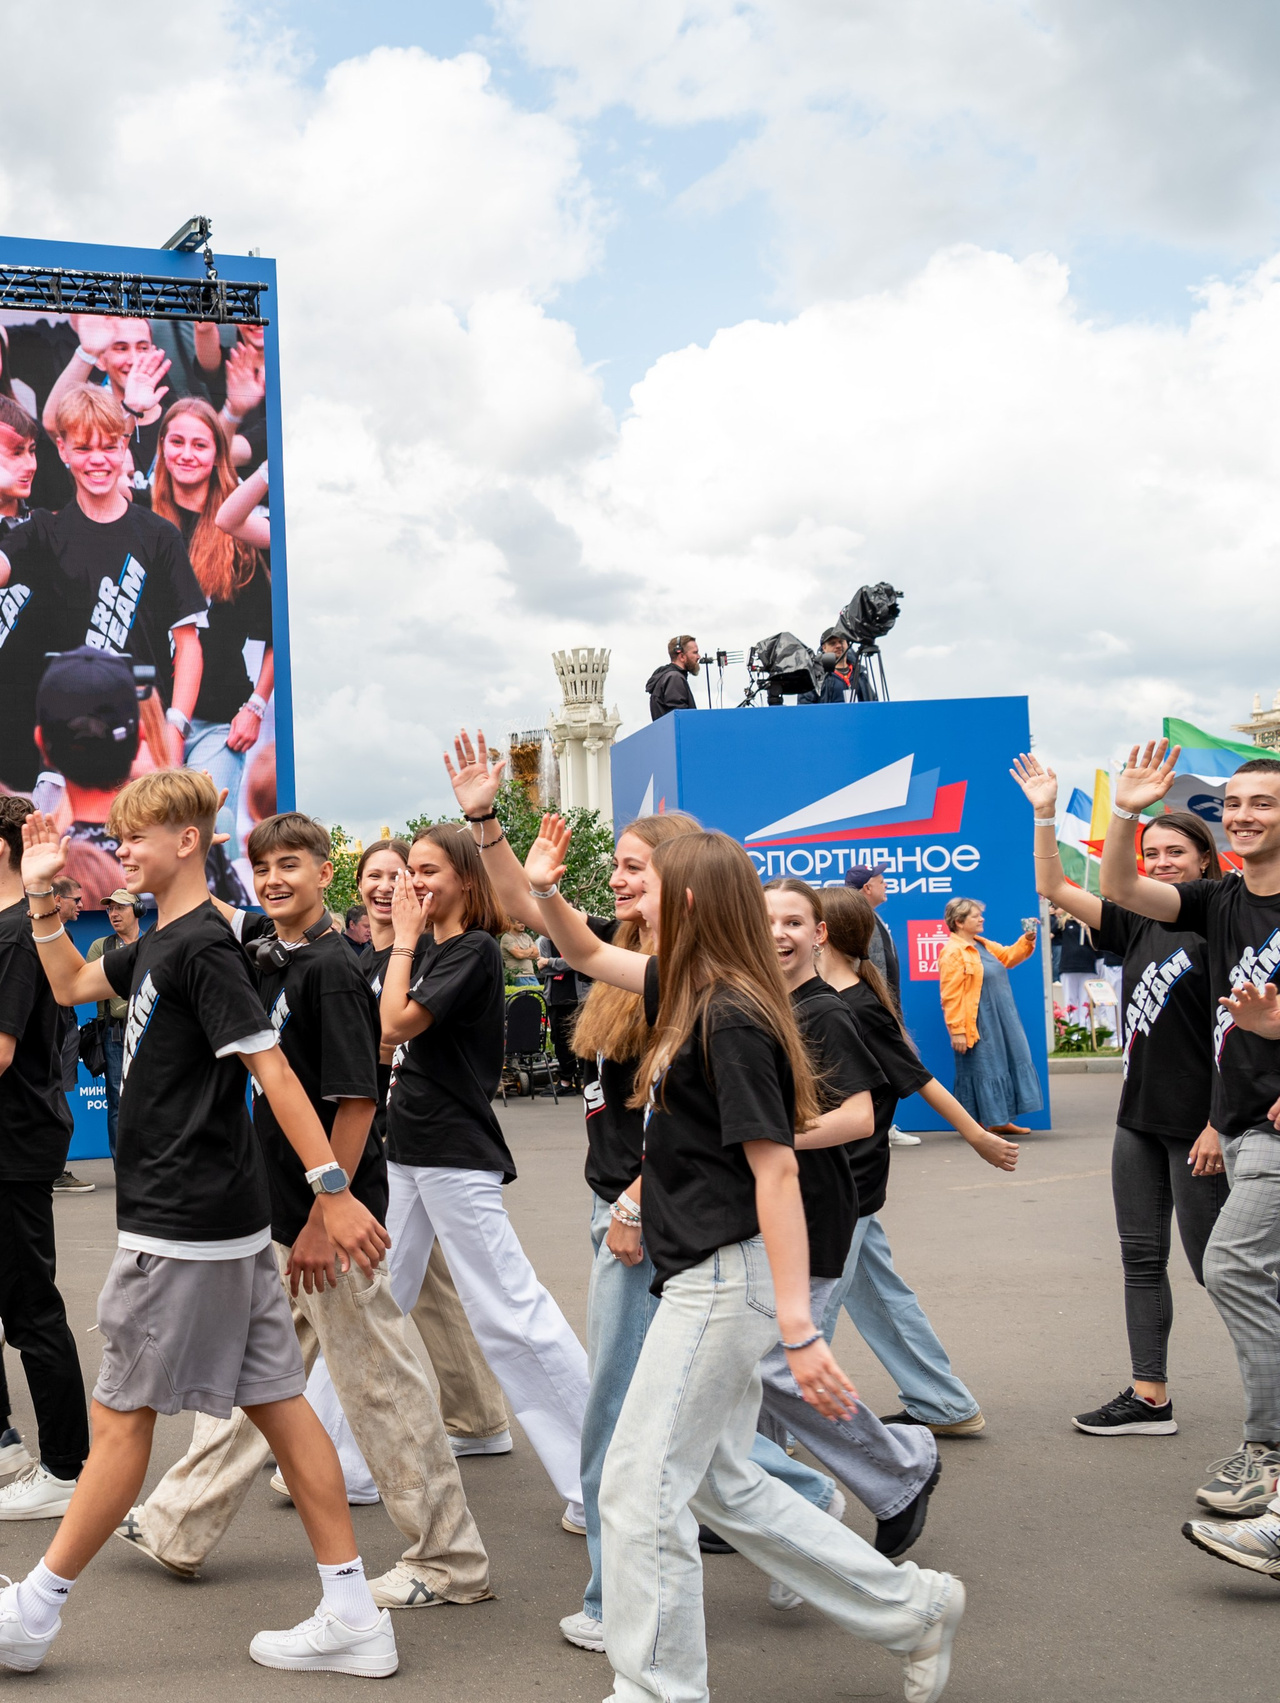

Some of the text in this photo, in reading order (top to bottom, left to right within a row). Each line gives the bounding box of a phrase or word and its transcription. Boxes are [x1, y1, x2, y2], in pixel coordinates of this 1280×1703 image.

[85, 575, 120, 651] ARR
[919, 960, 940, 973] ВД
[1136, 949, 1192, 1037] TEAM
[87, 1099, 109, 1110] РОС
